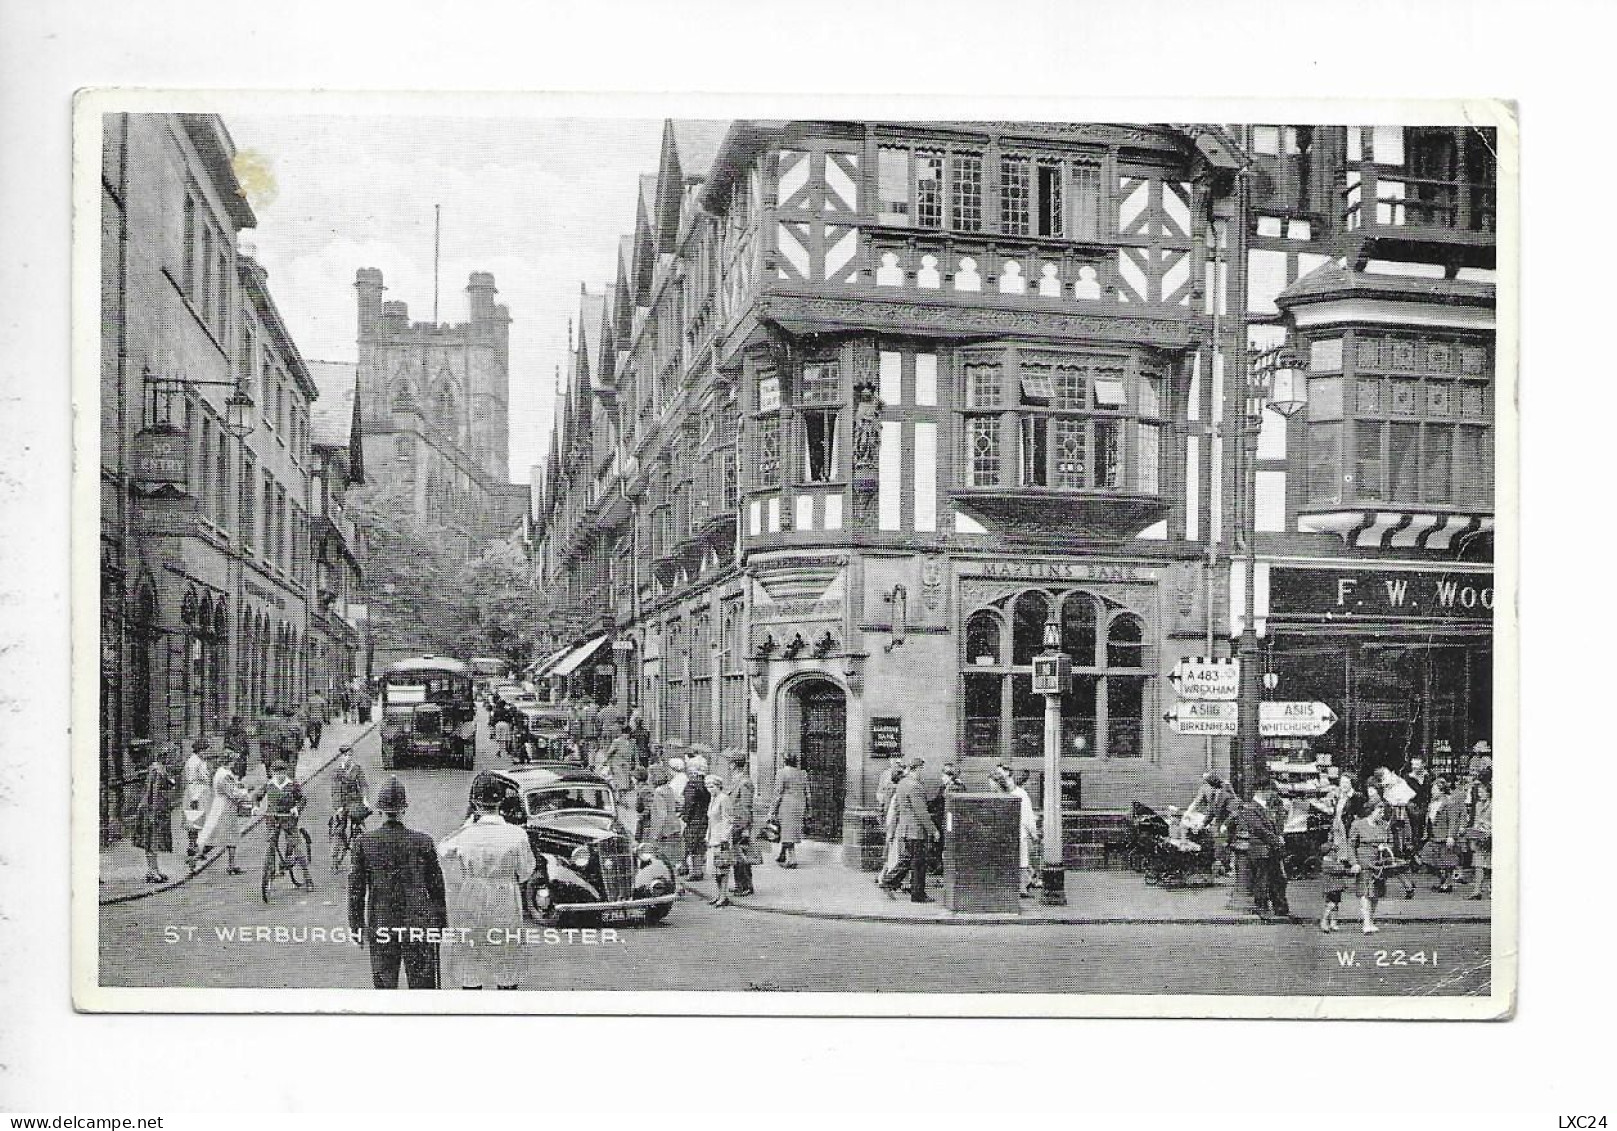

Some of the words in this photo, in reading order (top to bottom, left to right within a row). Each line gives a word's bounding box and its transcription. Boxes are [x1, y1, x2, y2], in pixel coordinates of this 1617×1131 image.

[1337, 578, 1363, 605] F.
[1386, 579, 1417, 606] W.
[1184, 684, 1236, 695] WREXHAM
[1180, 721, 1236, 731] BIRKENHEAD
[1261, 722, 1321, 732] WHITCHURCH
